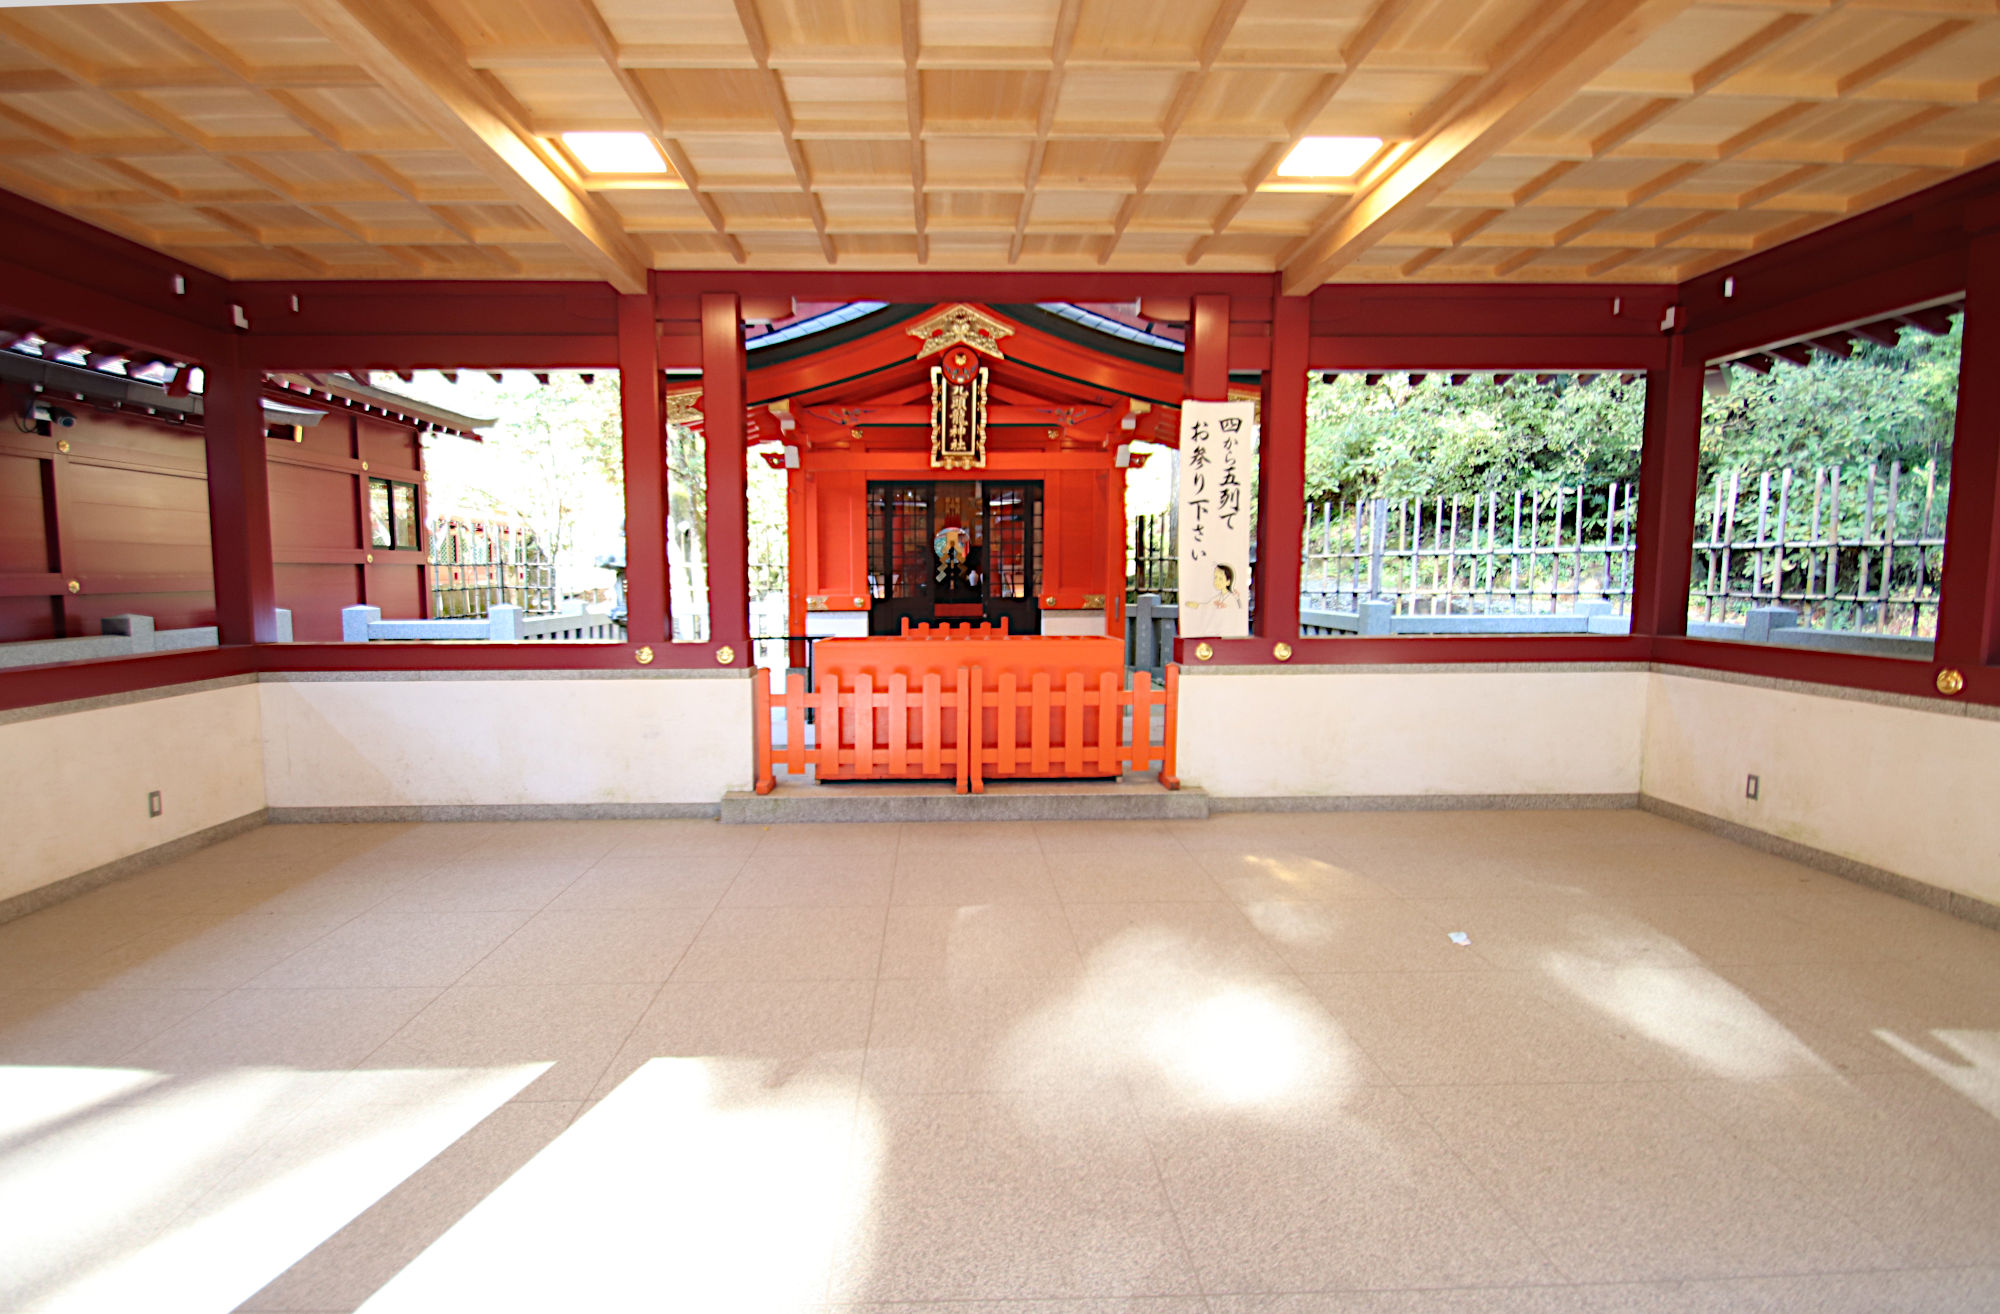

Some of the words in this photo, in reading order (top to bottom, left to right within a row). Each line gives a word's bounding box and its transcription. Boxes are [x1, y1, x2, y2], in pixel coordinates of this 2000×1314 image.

[1188, 420, 1211, 561] お参り下さい
